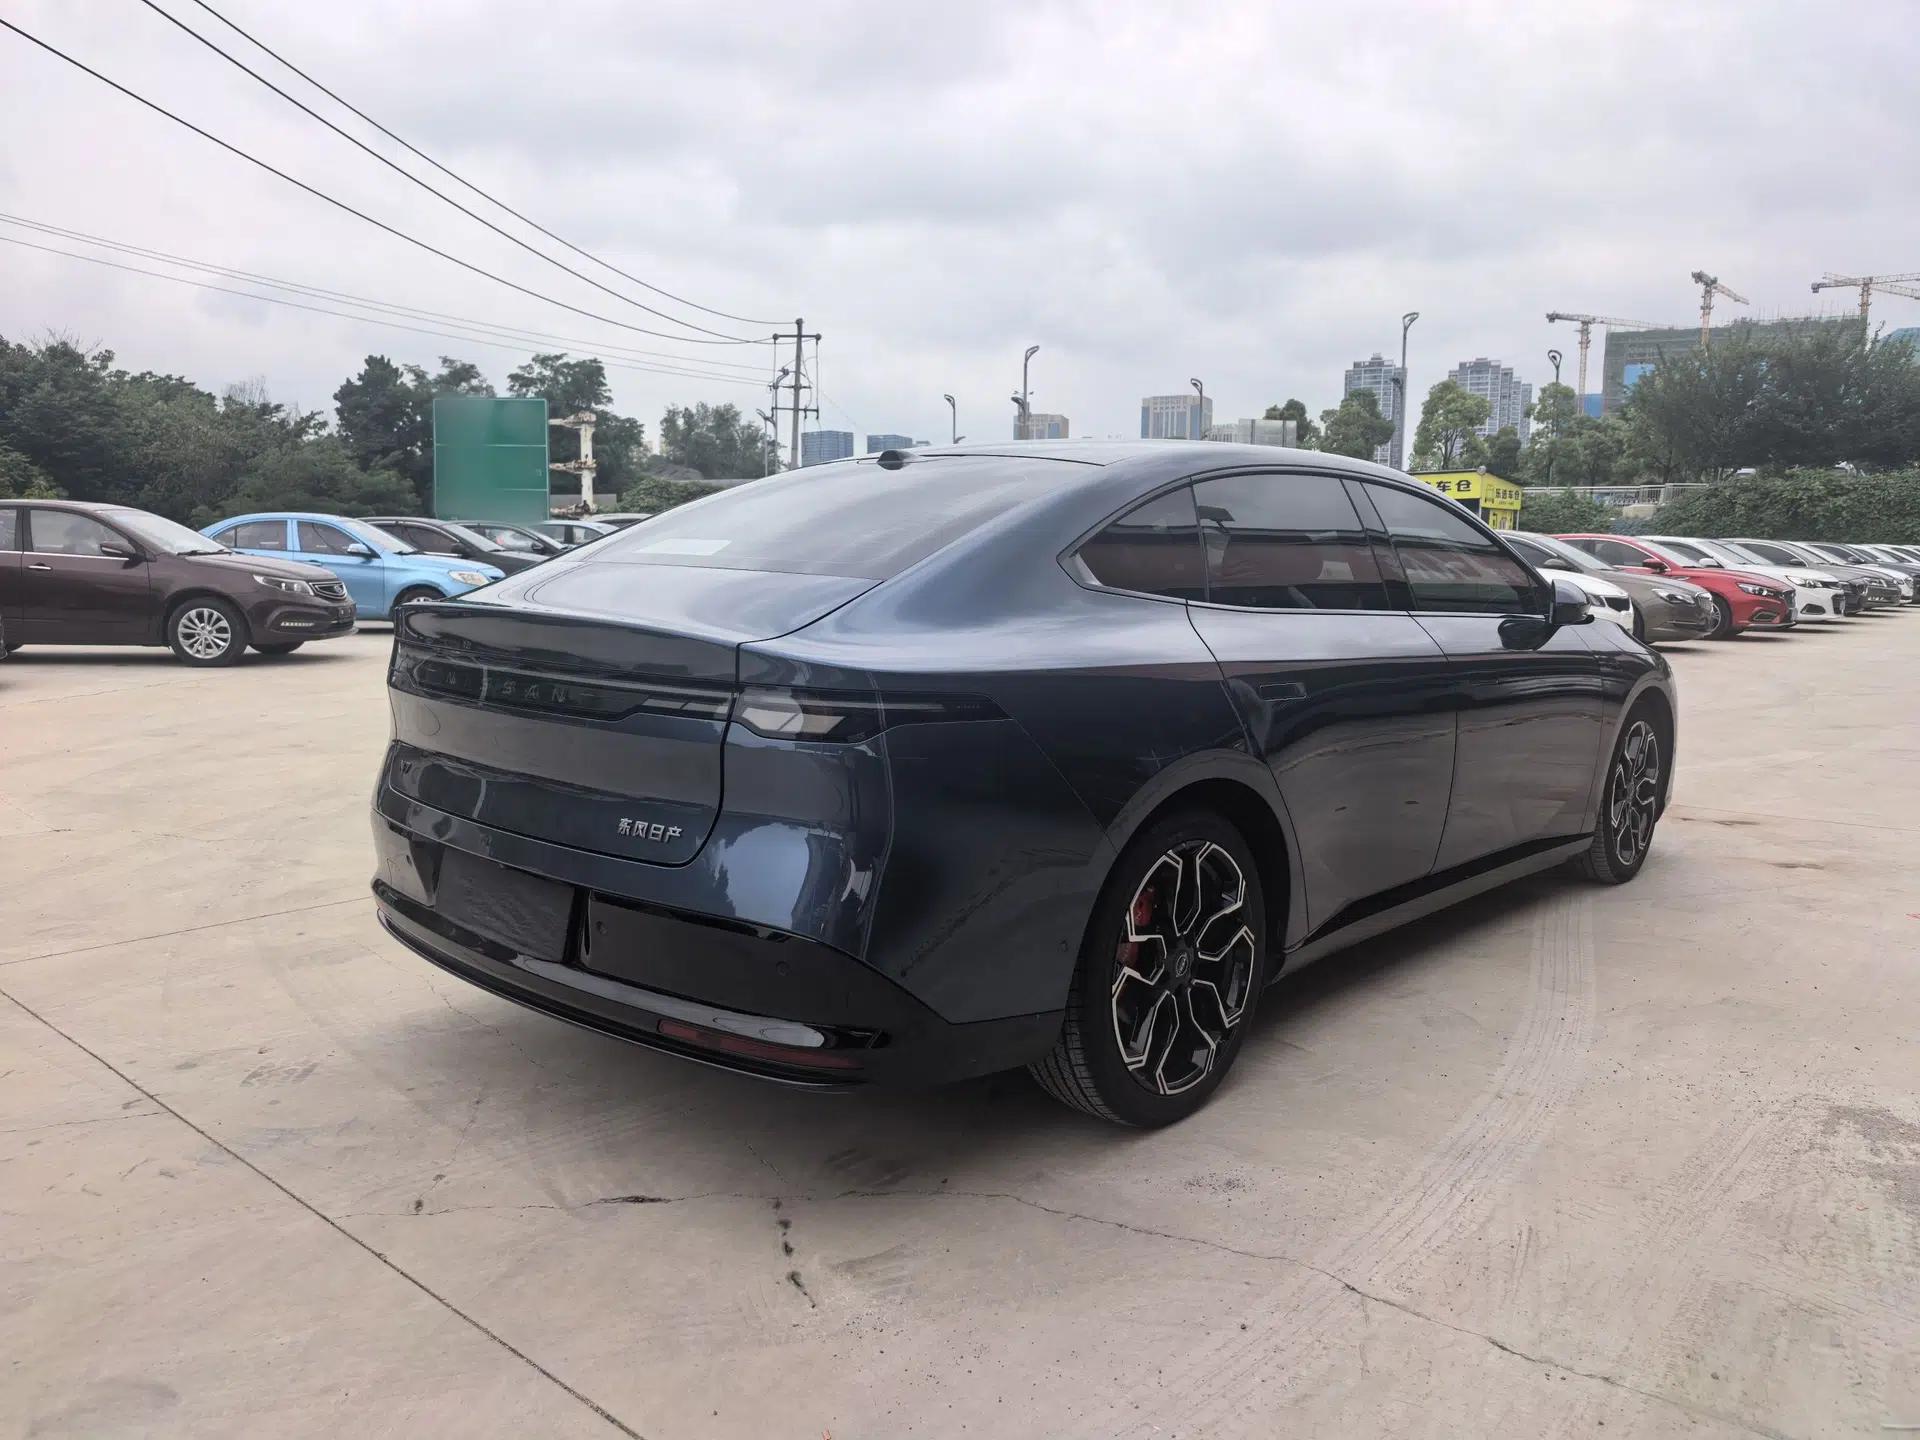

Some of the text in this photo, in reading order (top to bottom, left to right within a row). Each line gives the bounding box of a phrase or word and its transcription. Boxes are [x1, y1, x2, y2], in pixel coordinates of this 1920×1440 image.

[1425, 479, 1472, 493] 车仓
[617, 817, 683, 844] 东风日产
